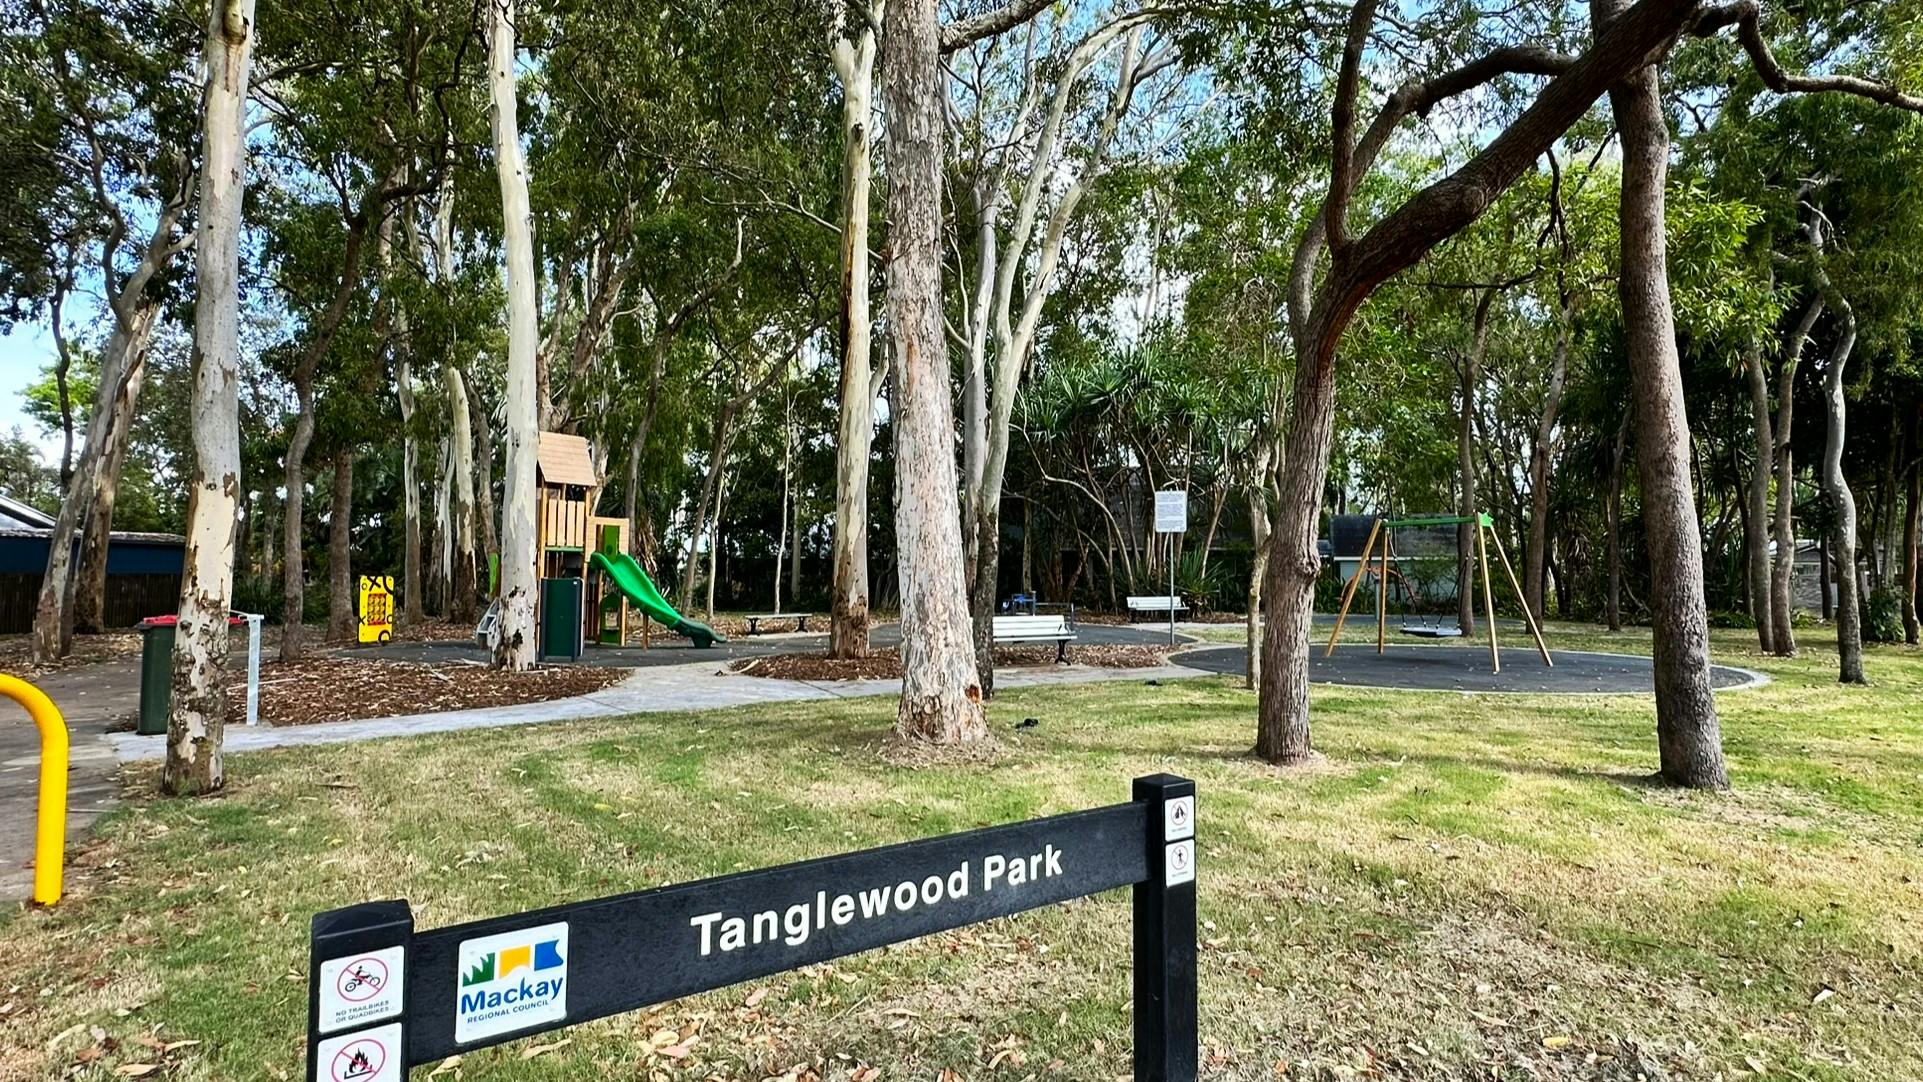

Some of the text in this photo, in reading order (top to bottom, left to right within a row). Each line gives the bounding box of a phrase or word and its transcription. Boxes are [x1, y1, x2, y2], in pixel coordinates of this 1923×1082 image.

[690, 843, 1063, 956] Tanglewood Park
[348, 1000, 389, 1013] TRAILBIKES
[461, 977, 563, 1014] Mackay
[348, 1007, 389, 1020] QUADBIKES
[467, 1000, 549, 1024] REGIONAL COUNCIL
